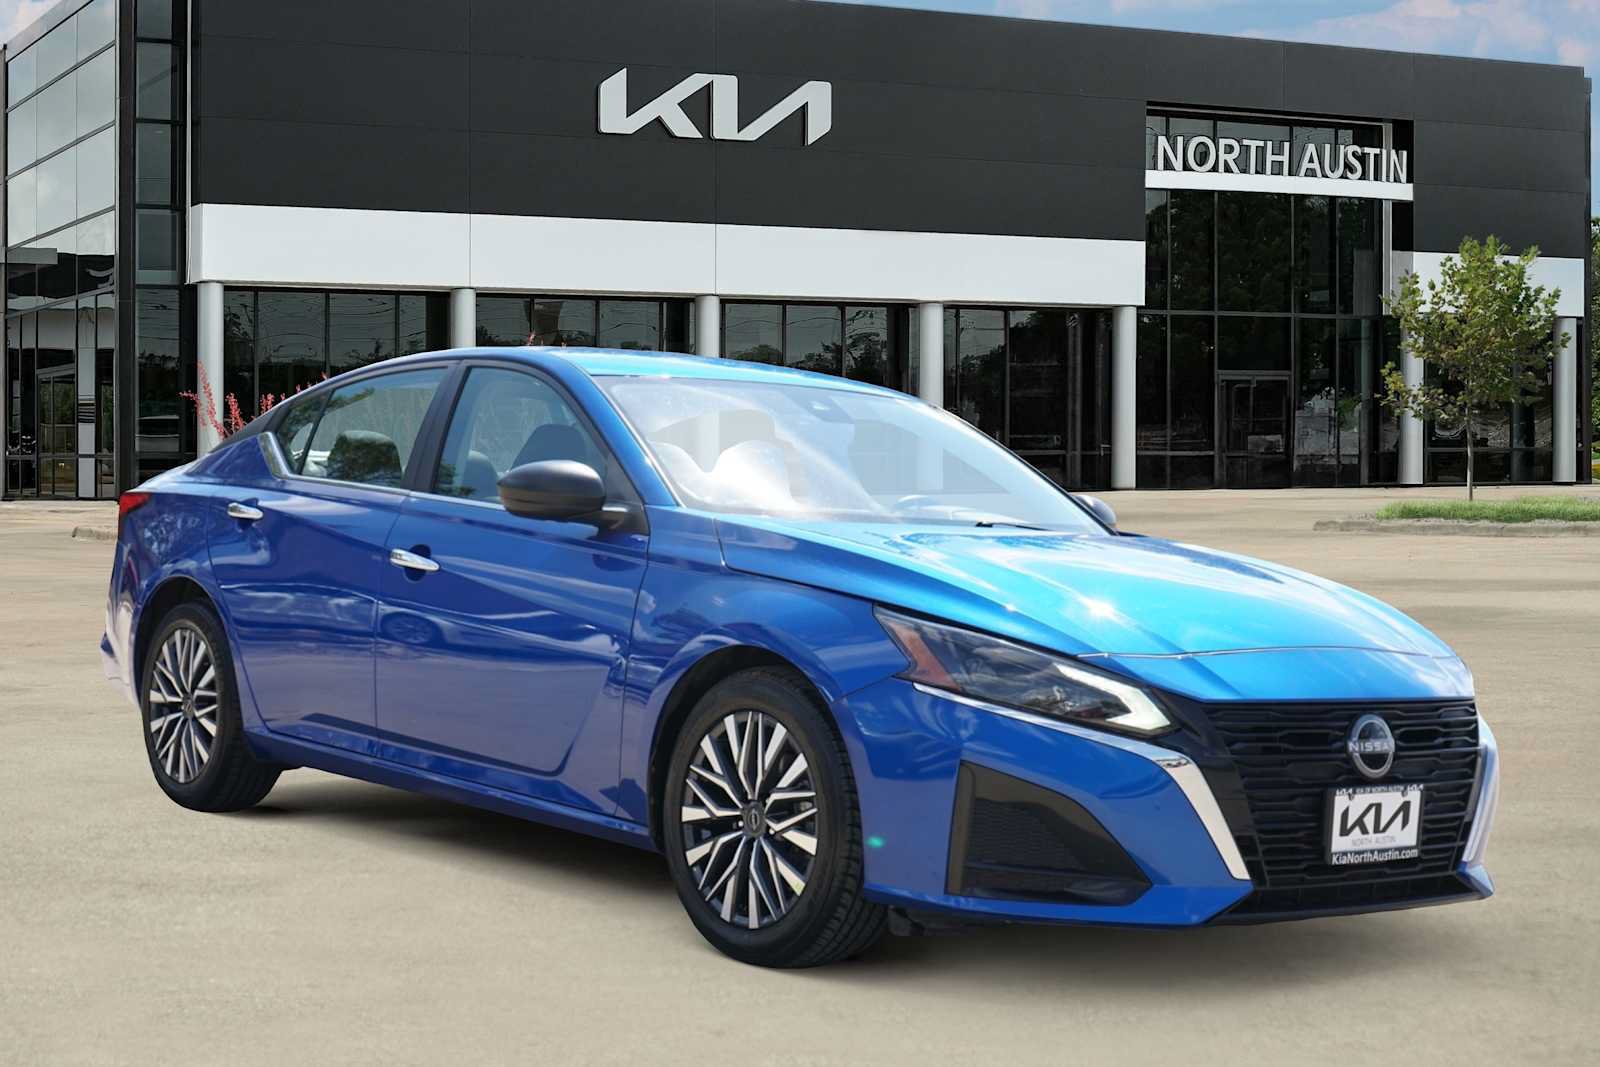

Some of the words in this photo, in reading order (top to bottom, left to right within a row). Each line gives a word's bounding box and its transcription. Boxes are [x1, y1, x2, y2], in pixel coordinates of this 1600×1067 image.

[598, 68, 832, 146] KIA
[1156, 135, 1290, 177] NORTH
[1299, 143, 1408, 184] AUSTIN
[1339, 800, 1411, 837] KIA
[1331, 848, 1418, 865] KiaNorthAustin.com
